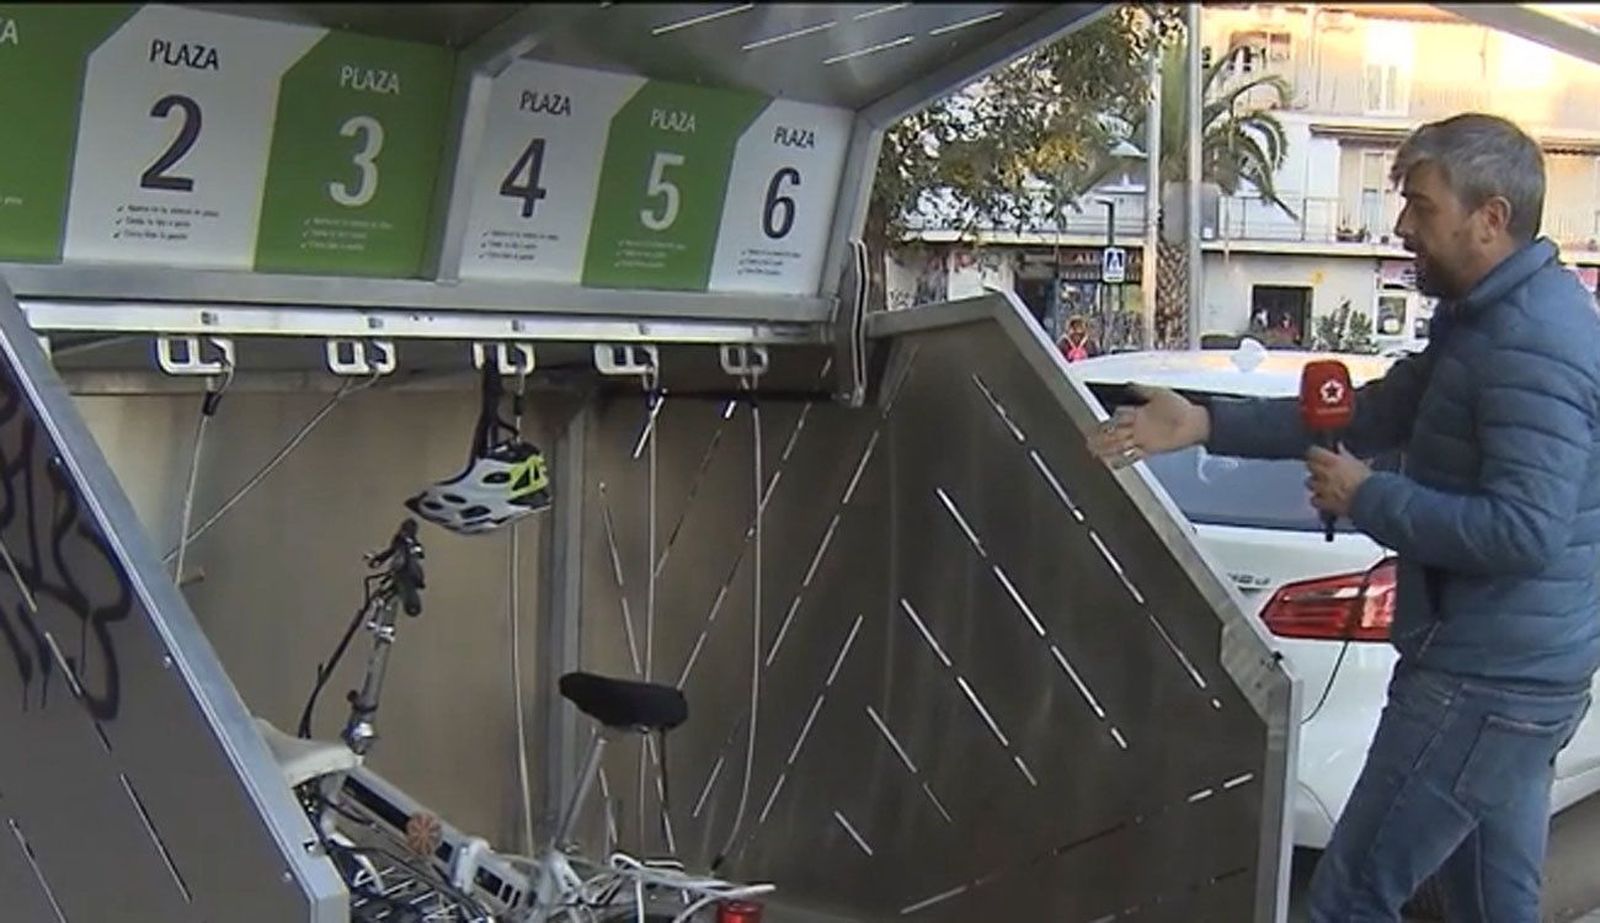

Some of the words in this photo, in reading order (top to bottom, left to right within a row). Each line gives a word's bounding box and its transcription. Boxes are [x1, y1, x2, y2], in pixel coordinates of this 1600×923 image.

[0, 19, 18, 45] A
[150, 39, 219, 71] PLAZA
[340, 65, 400, 94] PLAZA
[519, 90, 571, 117] PLAZA
[650, 108, 696, 133] PLAZA
[140, 94, 202, 192] 2
[773, 126, 815, 149] PLAZA
[329, 115, 385, 207] 3
[500, 138, 547, 218] 4
[640, 152, 685, 231] 5
[762, 167, 801, 239] 6
